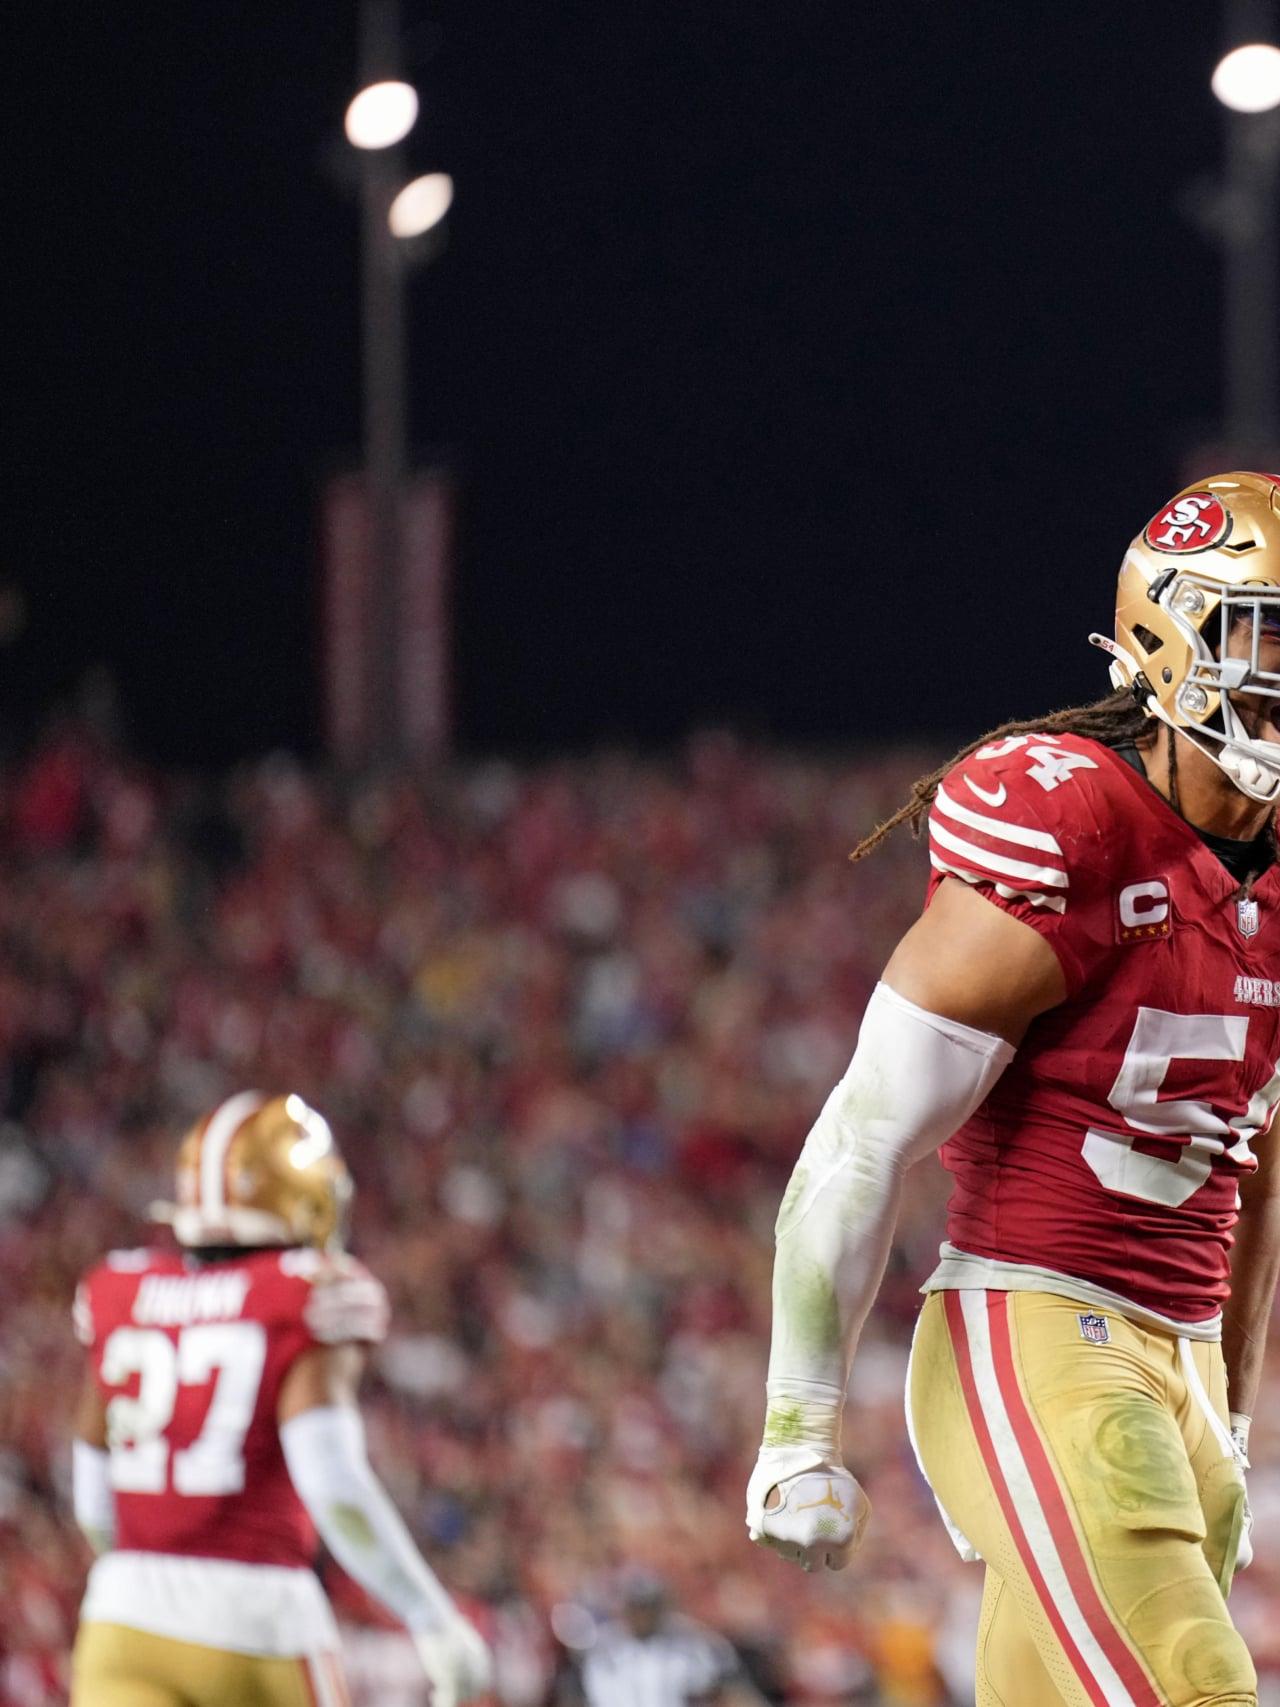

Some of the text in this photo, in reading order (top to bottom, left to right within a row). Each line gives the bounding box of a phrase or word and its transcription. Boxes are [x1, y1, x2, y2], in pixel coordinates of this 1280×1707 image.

[1119, 881, 1168, 927] C
[1083, 1325, 1107, 1340] NFL
[101, 1322, 268, 1496] 27
